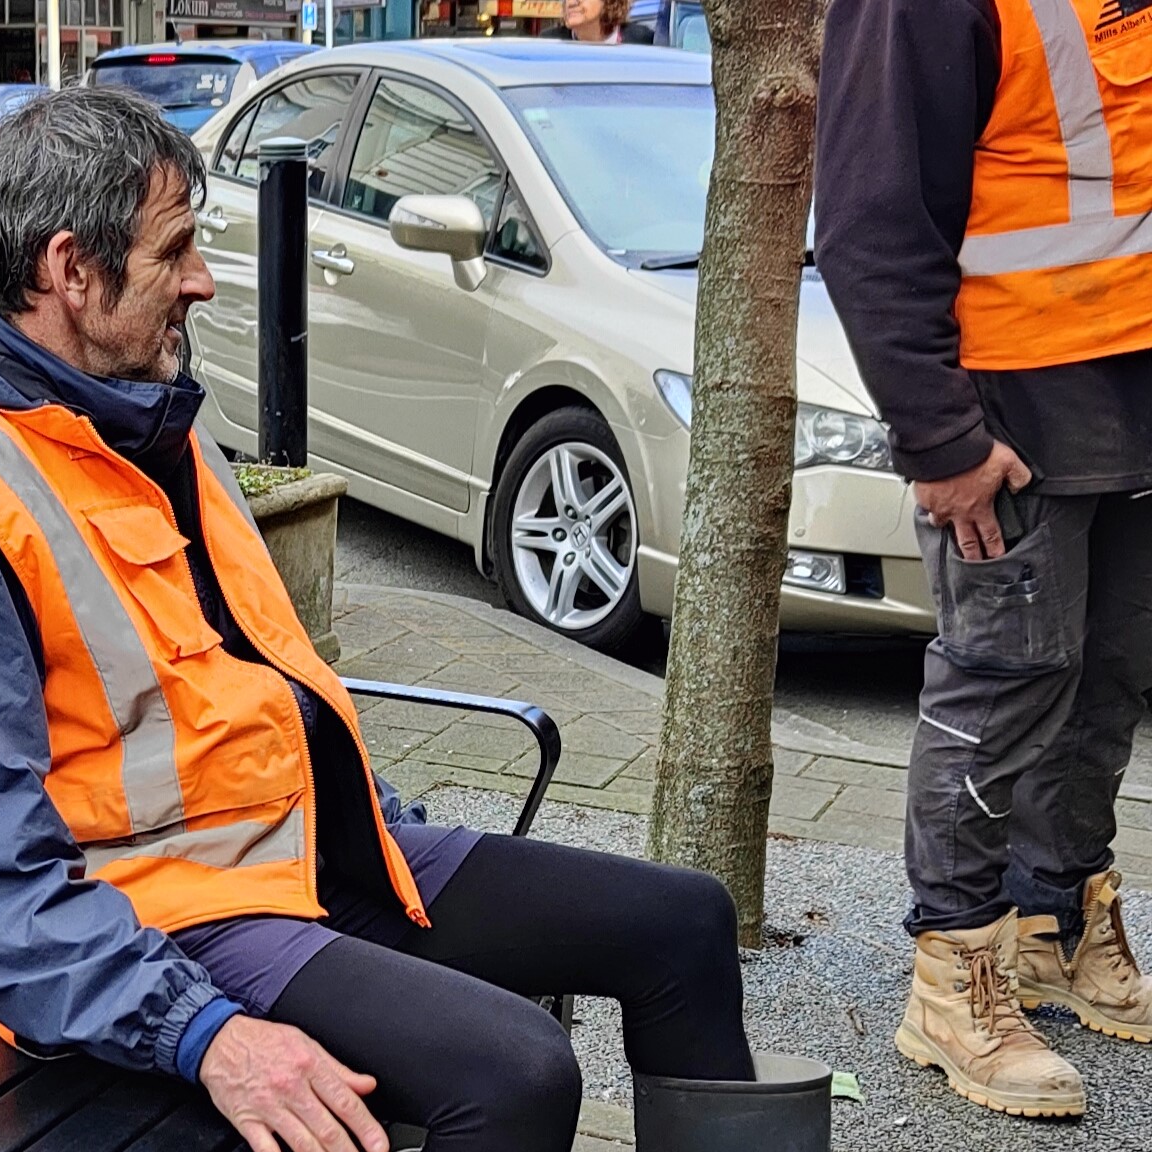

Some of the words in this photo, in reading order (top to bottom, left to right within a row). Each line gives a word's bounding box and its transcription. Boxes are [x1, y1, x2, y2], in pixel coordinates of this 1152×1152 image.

[169, 0, 208, 17] Lokum
[1094, 28, 1118, 43] Mills
[1121, 15, 1147, 33] Albert
